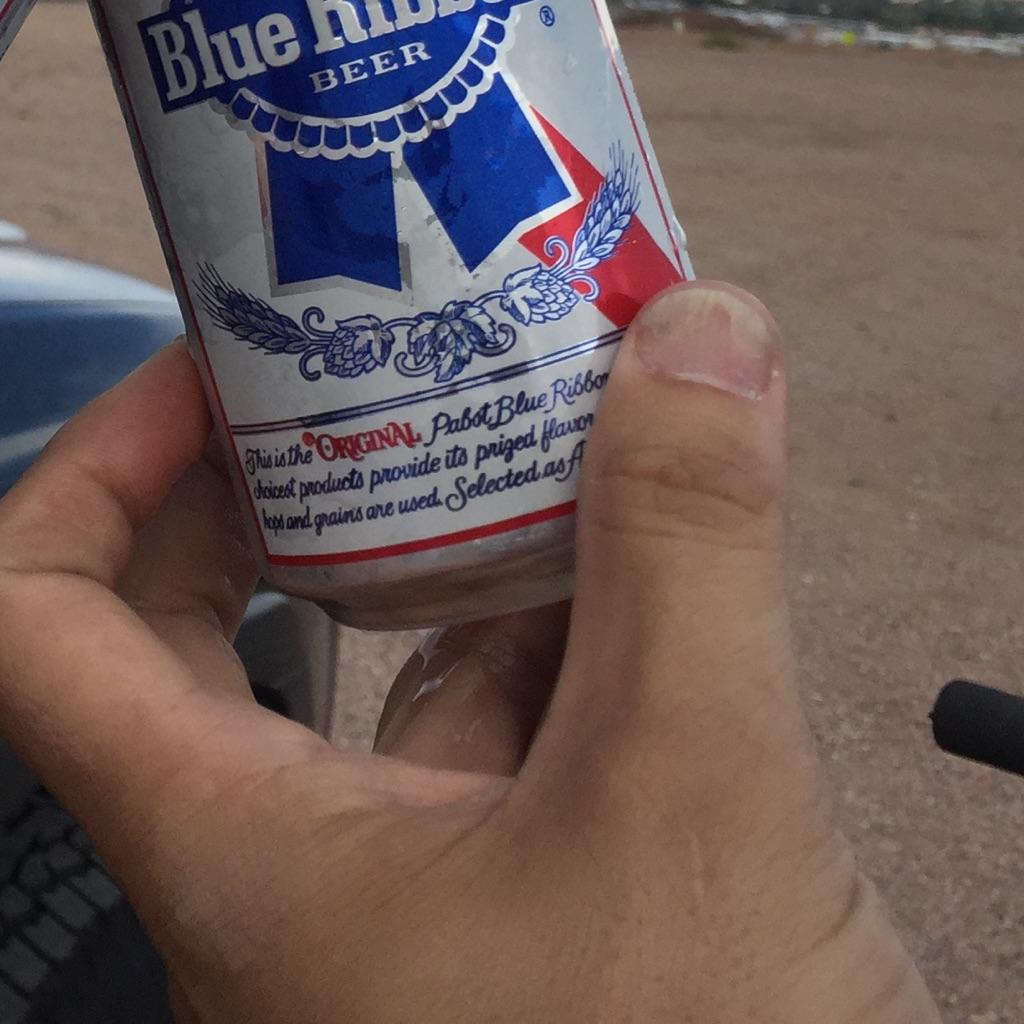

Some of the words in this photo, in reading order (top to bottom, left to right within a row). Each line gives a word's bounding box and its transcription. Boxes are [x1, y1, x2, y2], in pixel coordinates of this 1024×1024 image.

[147, 8, 301, 103] Blue
[309, 40, 433, 95] BEER
[244, 447, 273, 476] This
[287, 443, 313, 467] the
[423, 406, 493, 448] Pabst
[487, 389, 548, 431] Blue
[253, 476, 296, 500] choicest
[298, 471, 365, 505] products
[369, 451, 442, 494] provide
[444, 443, 468, 470] its
[473, 424, 538, 471] prized
[262, 507, 285, 537] hops
[286, 505, 313, 531] and
[314, 506, 364, 536] grains
[366, 501, 395, 520] are
[444, 459, 541, 512] Selected
[542, 457, 566, 479] as
